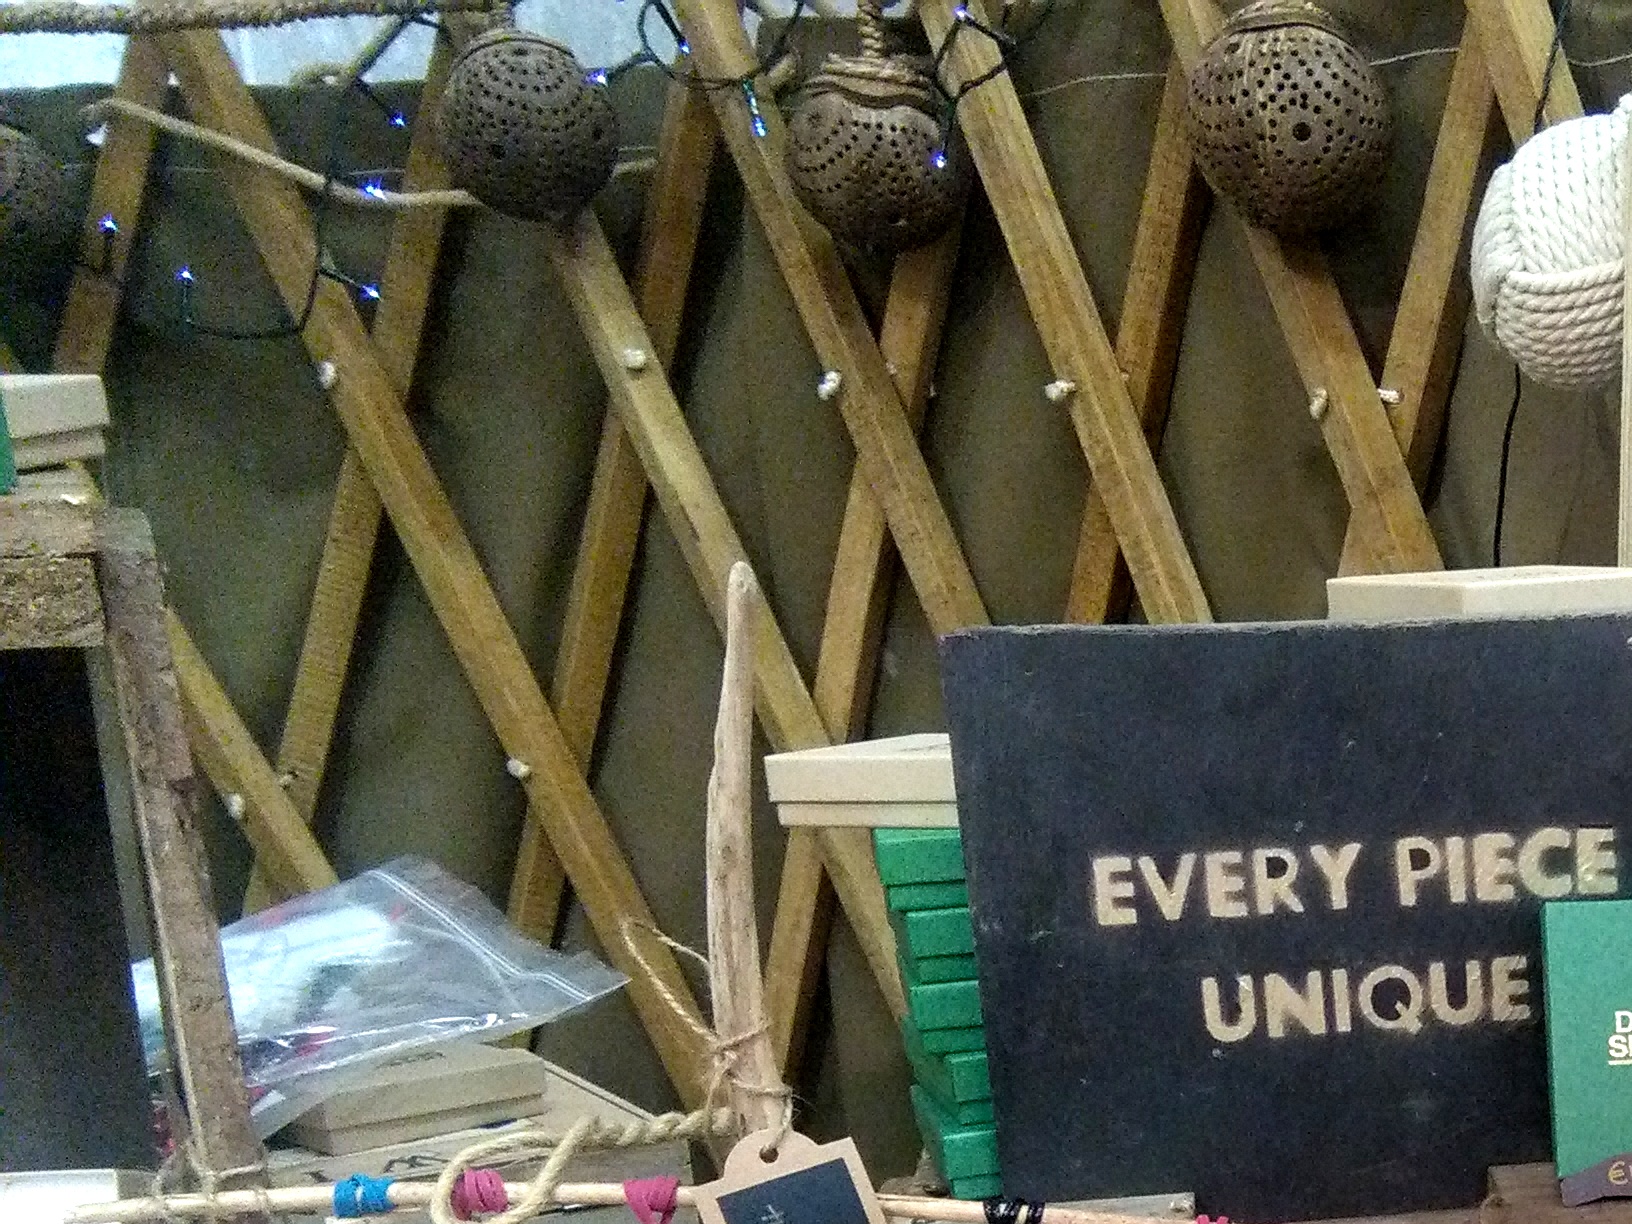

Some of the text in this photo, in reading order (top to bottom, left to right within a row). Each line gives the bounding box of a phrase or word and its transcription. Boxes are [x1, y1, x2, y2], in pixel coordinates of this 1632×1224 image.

[1091, 826, 1619, 927] EVERY PIECE
[1201, 954, 1532, 1043] UNIQUE
